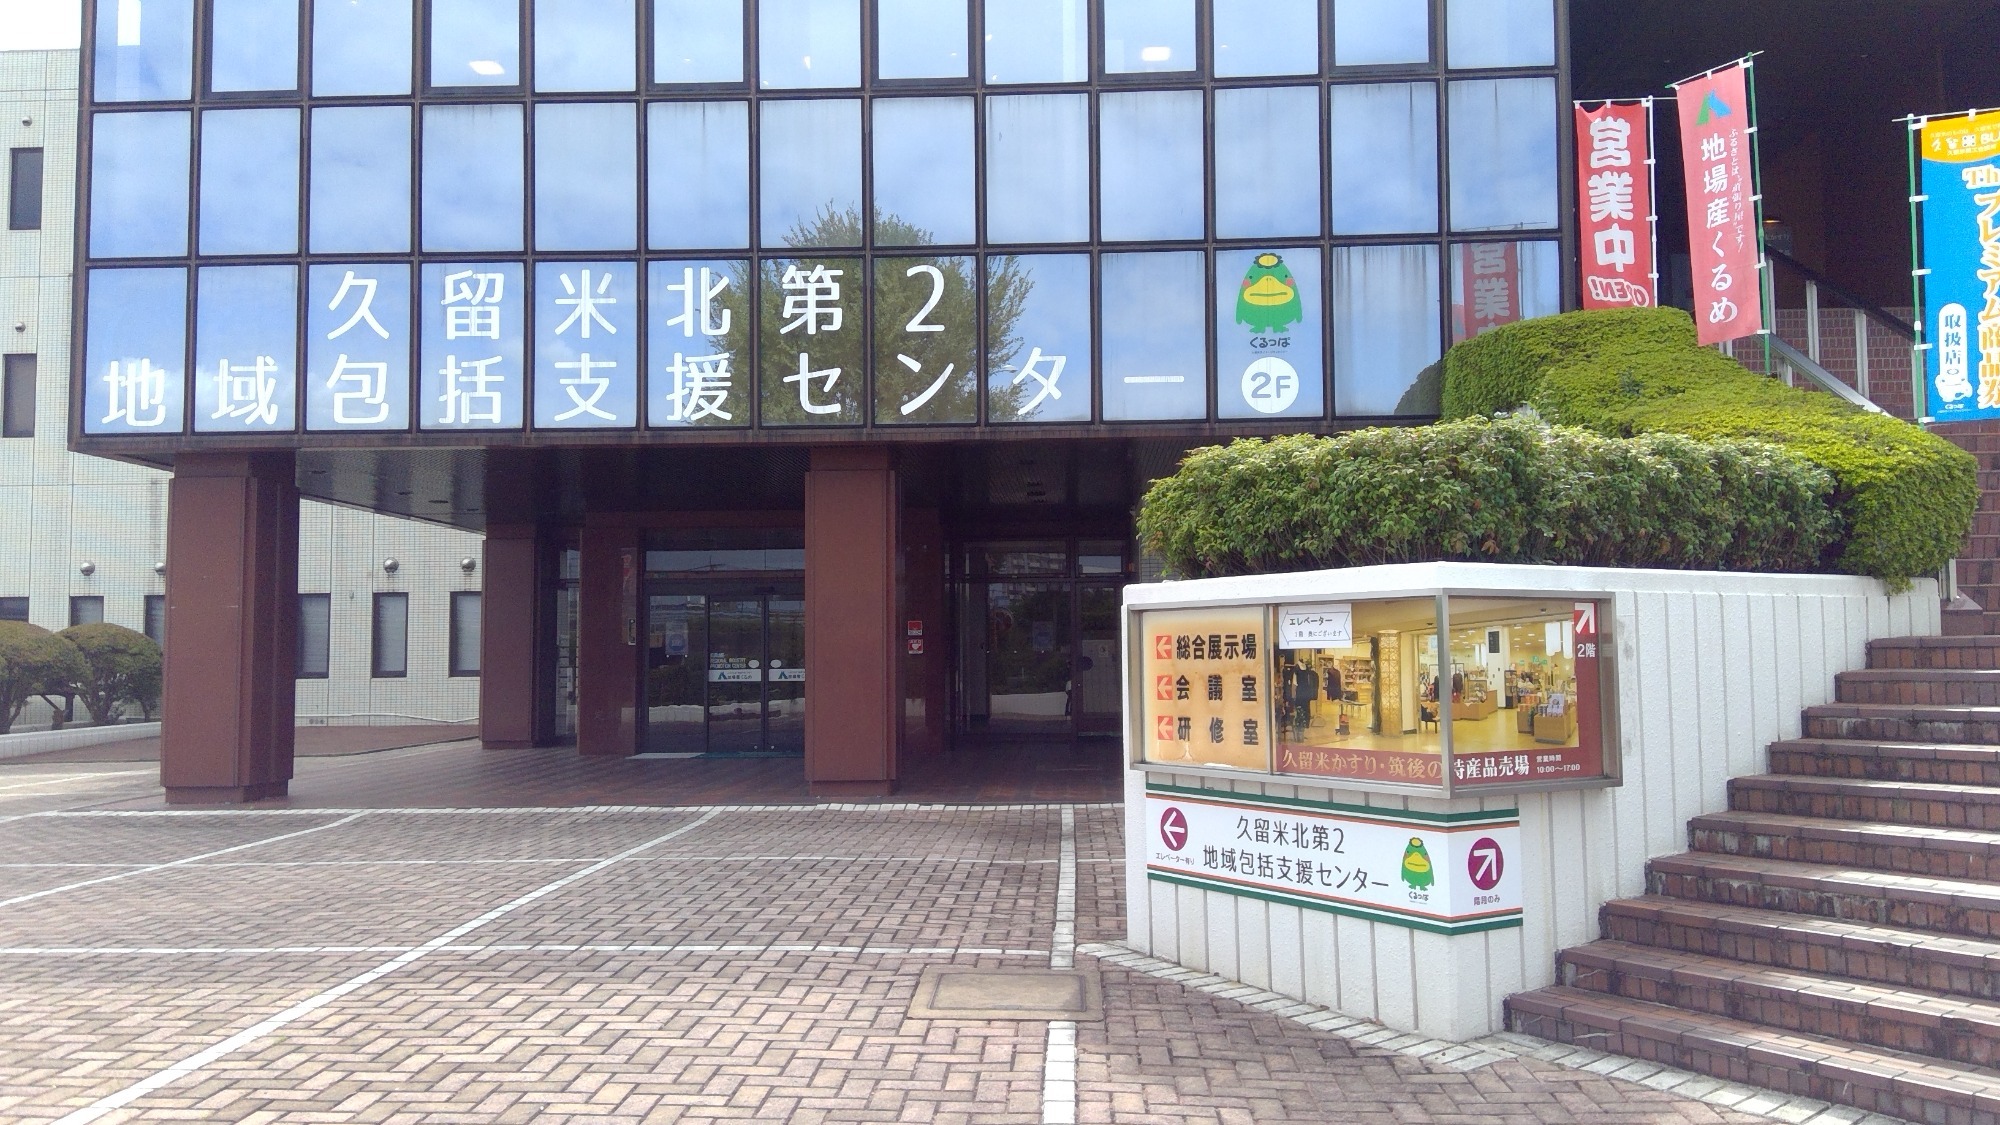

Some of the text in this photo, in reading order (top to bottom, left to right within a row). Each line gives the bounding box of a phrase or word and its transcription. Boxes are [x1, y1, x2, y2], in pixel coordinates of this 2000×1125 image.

[1587, 115, 1636, 273] 営業中
[1700, 132, 1739, 325] 地場産くるめ
[327, 264, 946, 341] 久留米北第2
[101, 346, 1185, 427] 地域包括支援センター
[1250, 371, 1292, 399] 2F
[1289, 615, 1333, 626] エレベーター
[1176, 633, 1257, 660] 総合展示場
[1577, 642, 1597, 658] 2階
[1175, 674, 1258, 702] 会議室
[1177, 716, 1259, 745] 研修室
[1536, 754, 1562, 763] 営業時間
[1236, 815, 1345, 855] 久留米北第2
[1202, 844, 1390, 893] 地域包括支援センター
[1473, 894, 1501, 906] 階段のみ
